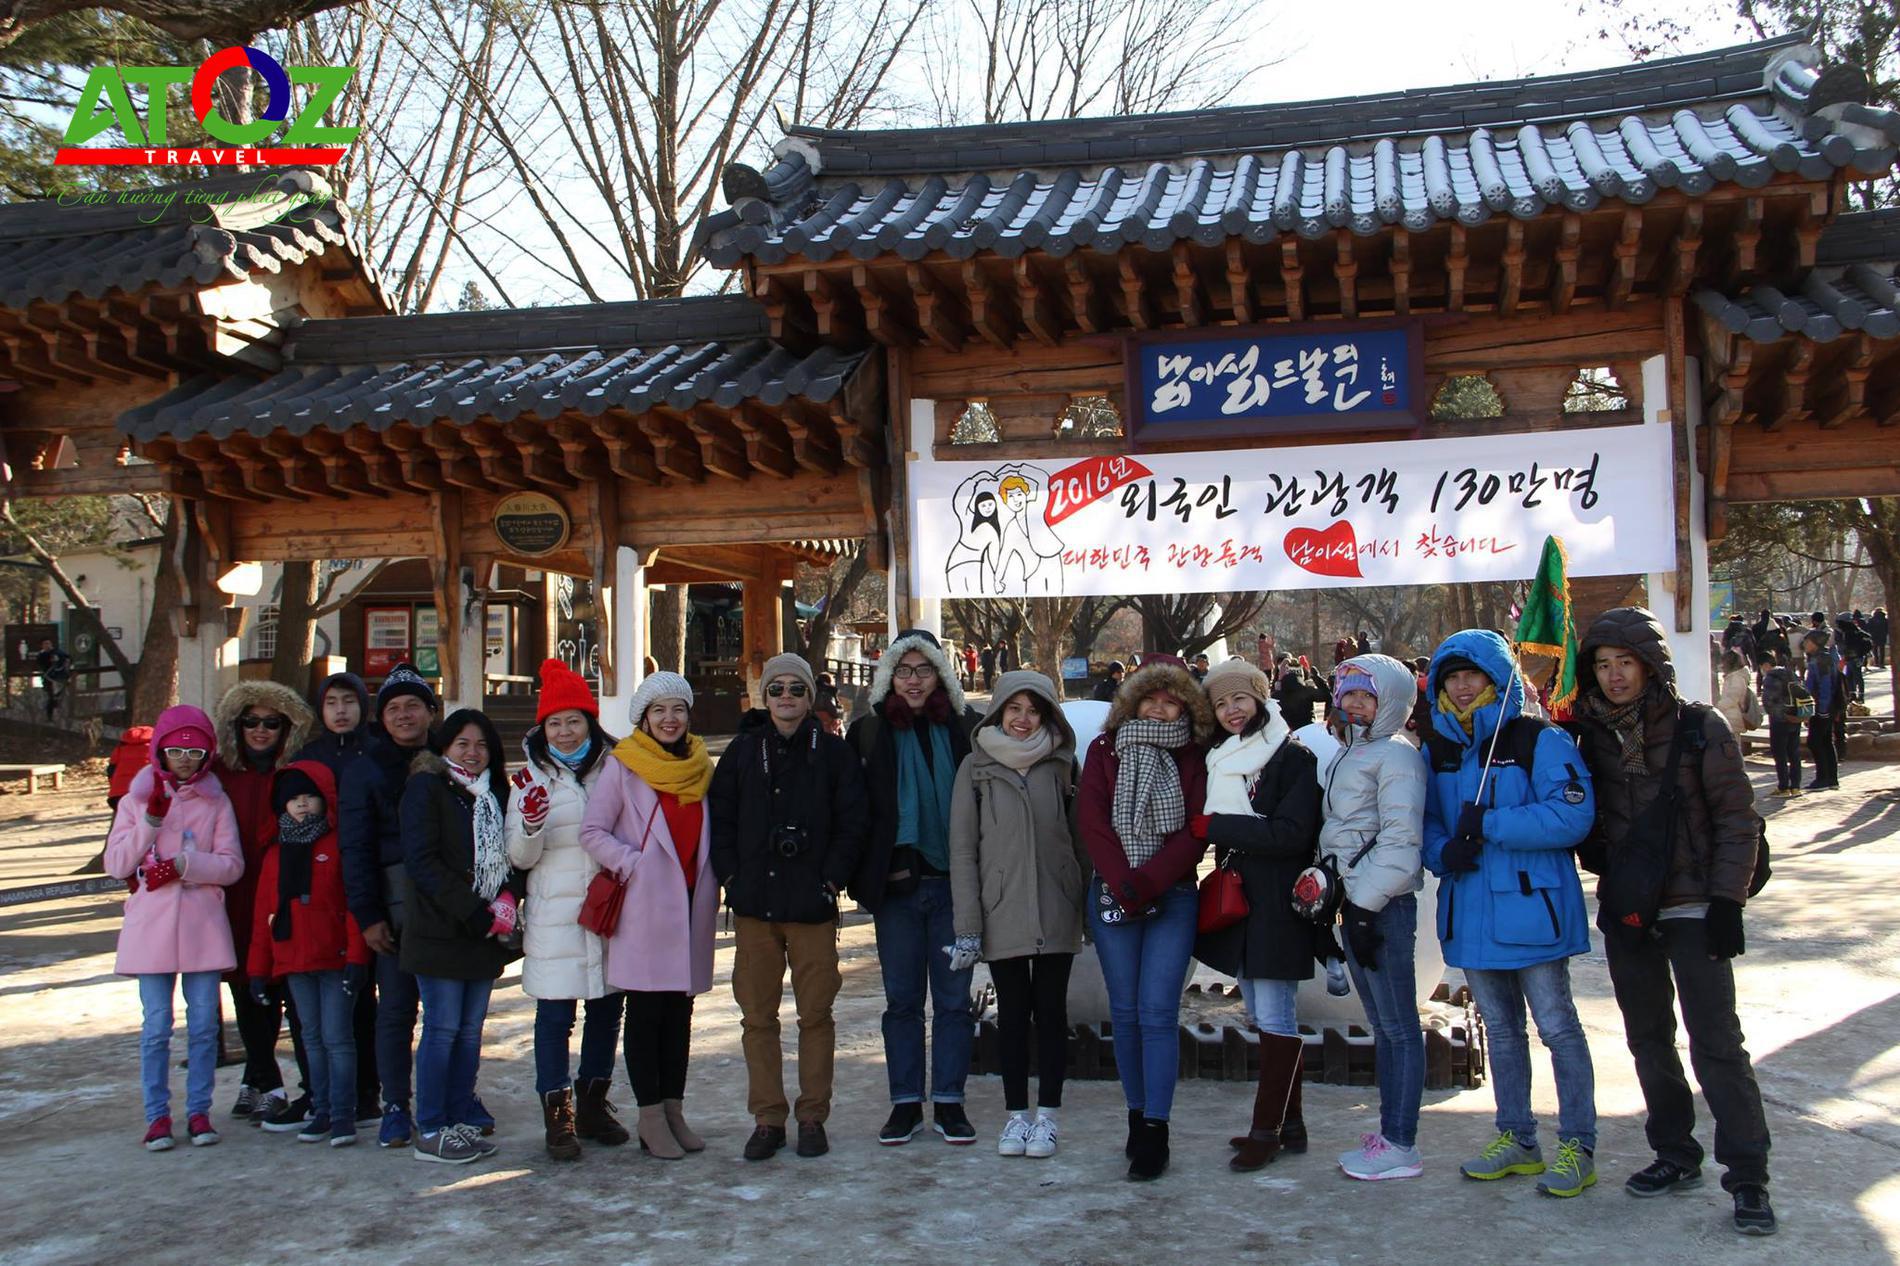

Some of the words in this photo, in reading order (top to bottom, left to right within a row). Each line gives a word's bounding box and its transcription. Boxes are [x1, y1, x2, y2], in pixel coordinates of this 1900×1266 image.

[1050, 456, 1133, 518] 2016년
[1120, 474, 1238, 523] 외국인
[1264, 466, 1400, 517] 관광객
[1430, 452, 1600, 514] 130만명
[1063, 544, 1151, 573] 대한민국
[1168, 538, 1263, 568] 관광품격
[1416, 523, 1518, 560] 찾습니다
